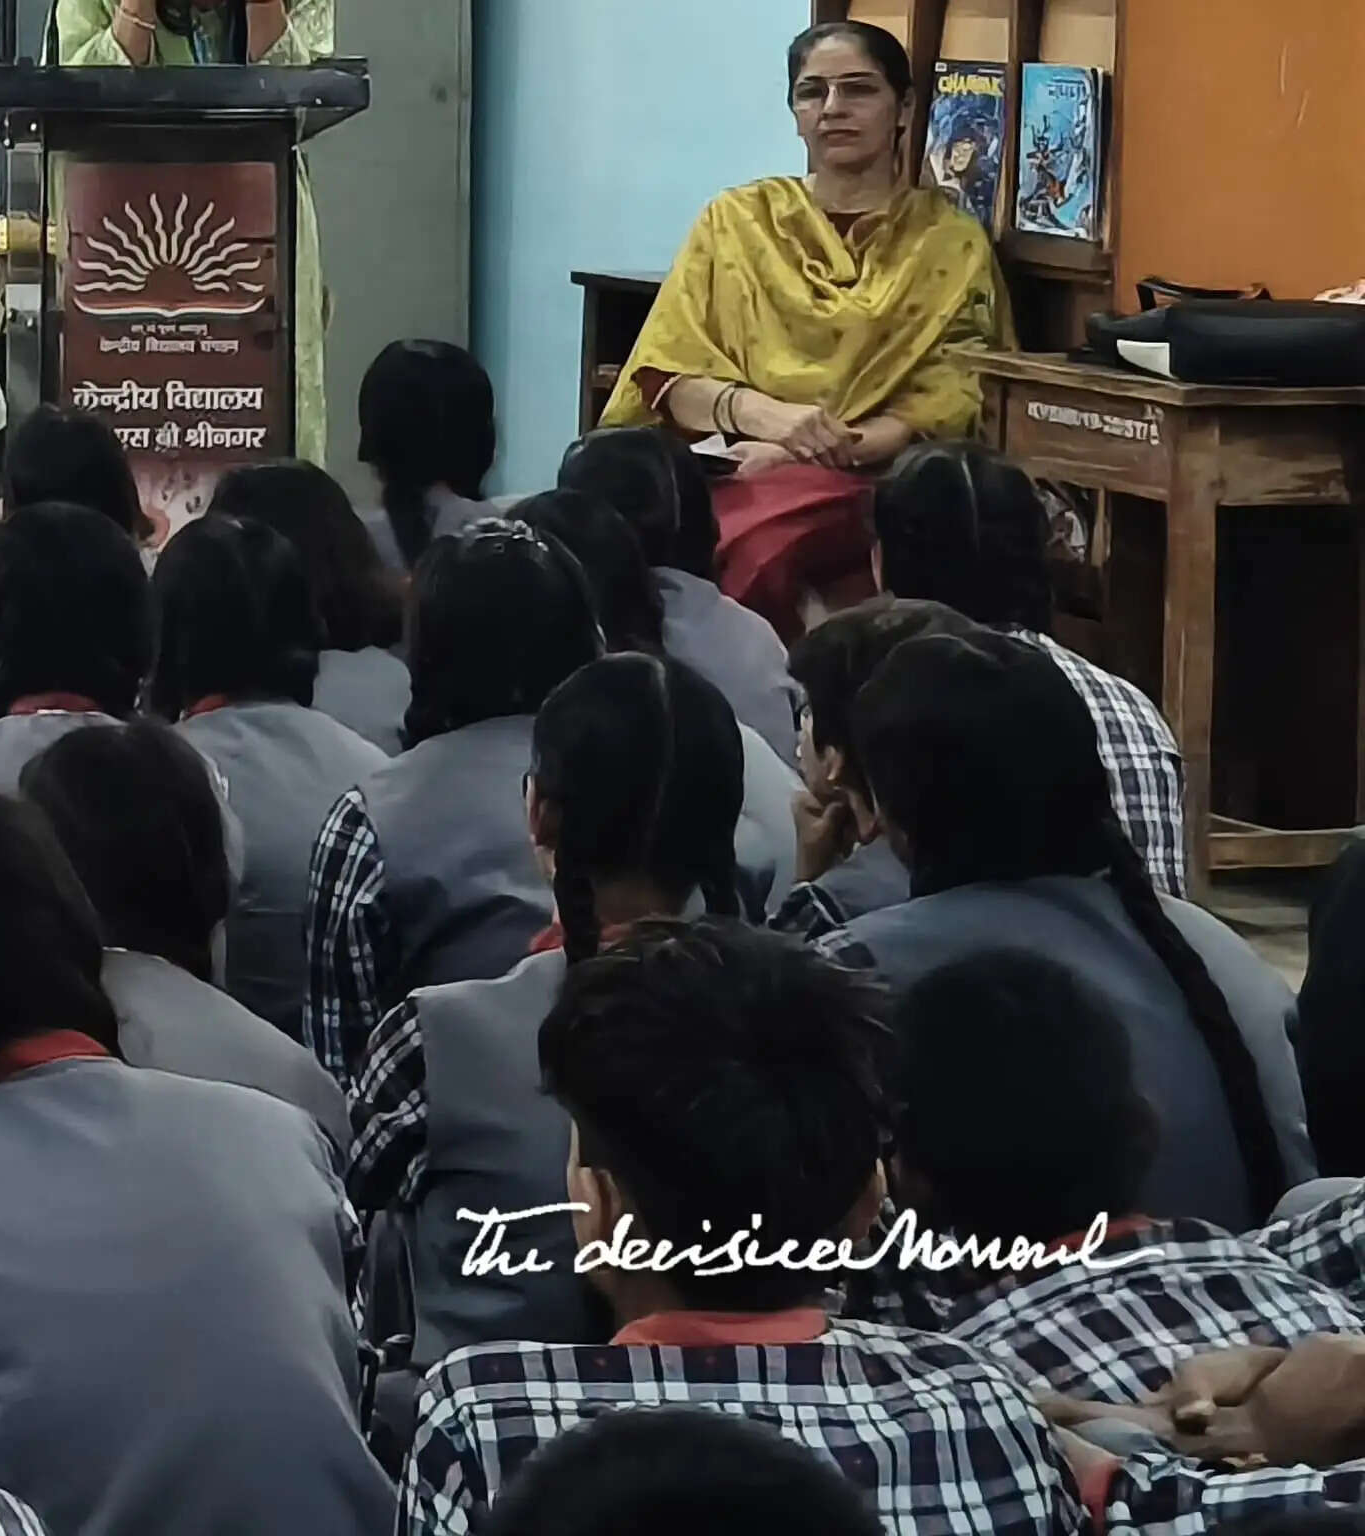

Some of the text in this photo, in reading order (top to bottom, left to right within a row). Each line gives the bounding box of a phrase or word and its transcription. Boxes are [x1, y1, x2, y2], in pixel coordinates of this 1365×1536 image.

[72, 380, 264, 413] केन्द्रीय विद्यालय
[185, 420, 267, 449] श्रीनगर
